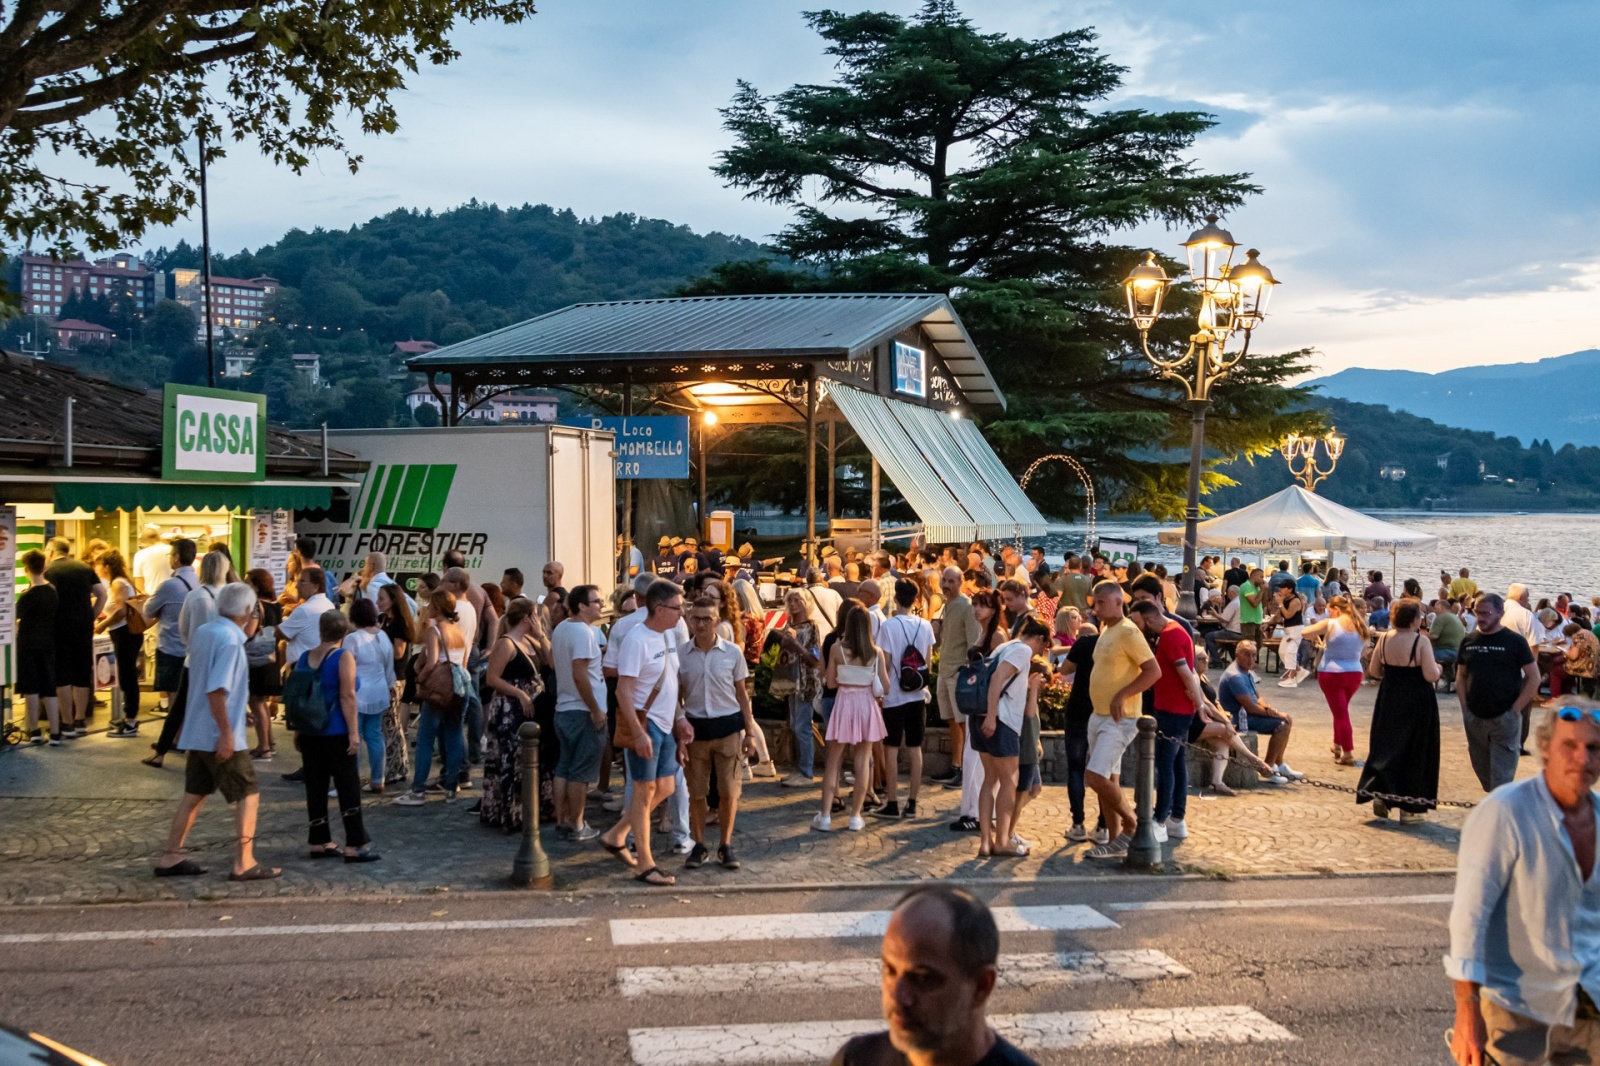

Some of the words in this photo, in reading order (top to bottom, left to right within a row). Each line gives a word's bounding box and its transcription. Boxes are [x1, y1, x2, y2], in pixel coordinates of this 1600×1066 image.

[179, 409, 254, 455] CASSA
[622, 418, 652, 436] Loco
[619, 440, 683, 456] MOMBELLO
[616, 461, 640, 476] RRO
[298, 533, 352, 555] TIT
[354, 532, 488, 555] FORESTIER
[1237, 536, 1301, 548] Hacker-Pschorr
